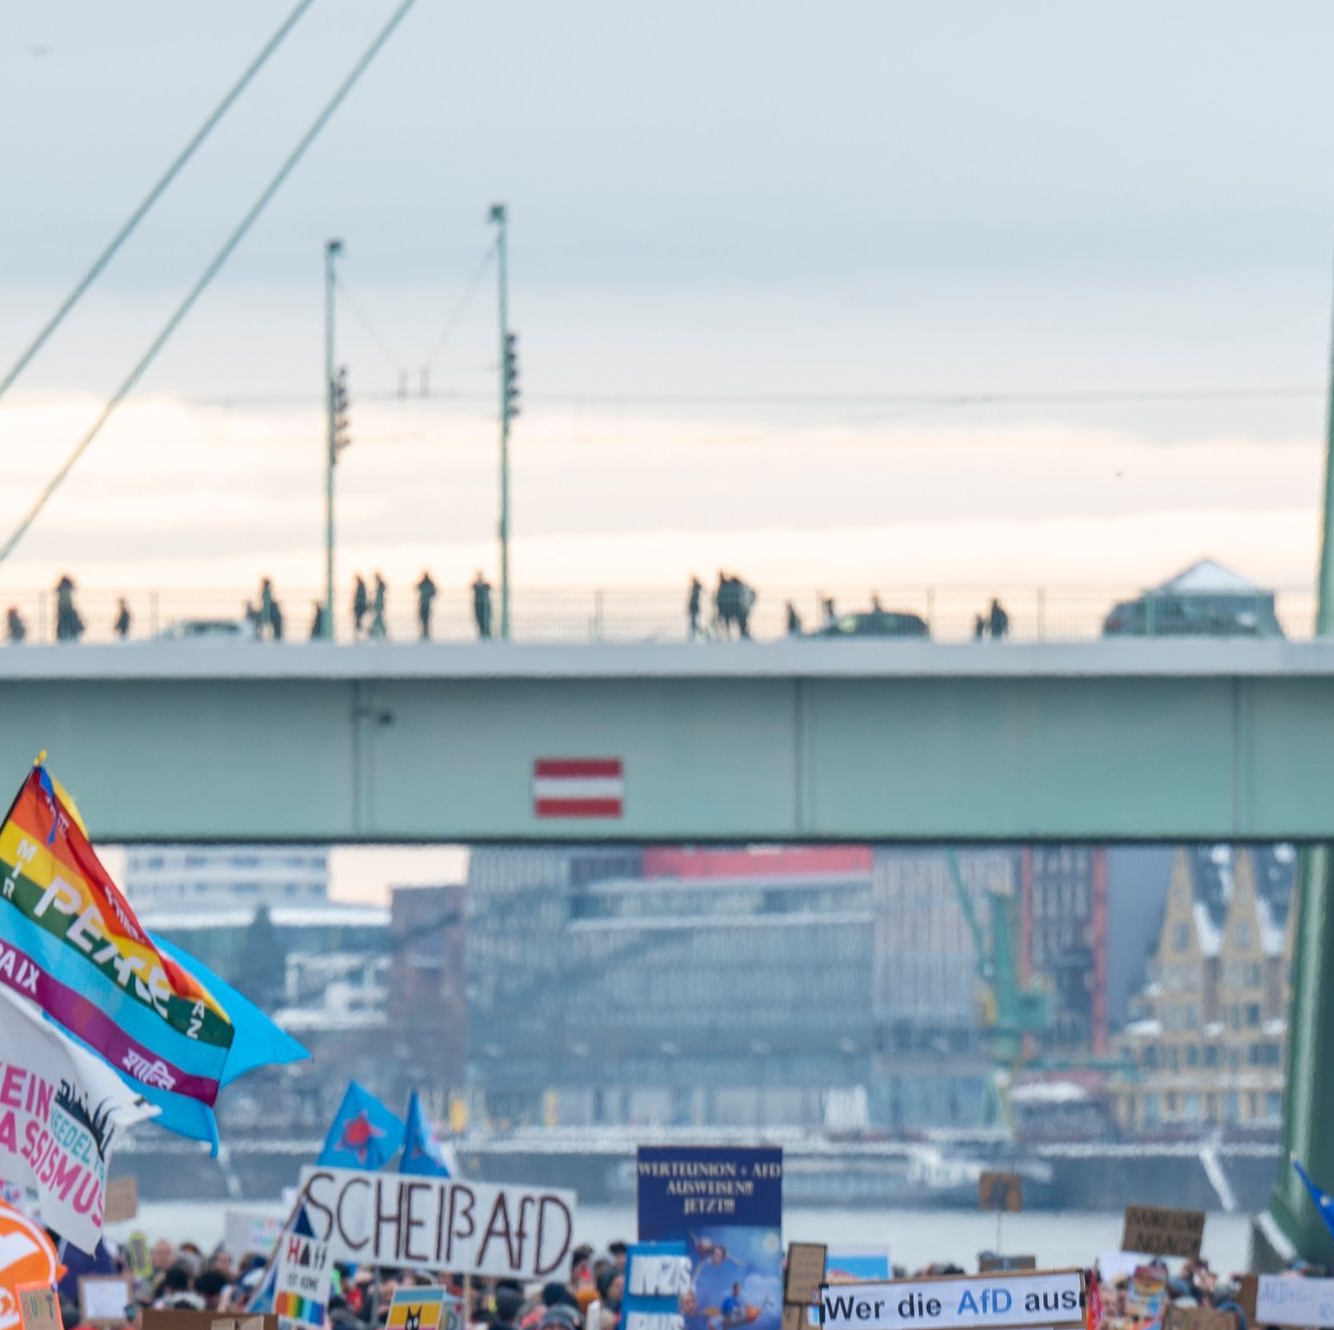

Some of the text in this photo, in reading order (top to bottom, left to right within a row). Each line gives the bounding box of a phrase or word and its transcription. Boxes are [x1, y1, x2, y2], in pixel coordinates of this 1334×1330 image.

[477, 1190, 573, 1276] AfD
[629, 1256, 692, 1297] NAZIS
[824, 1287, 1077, 1321] Wer die AfD aus
